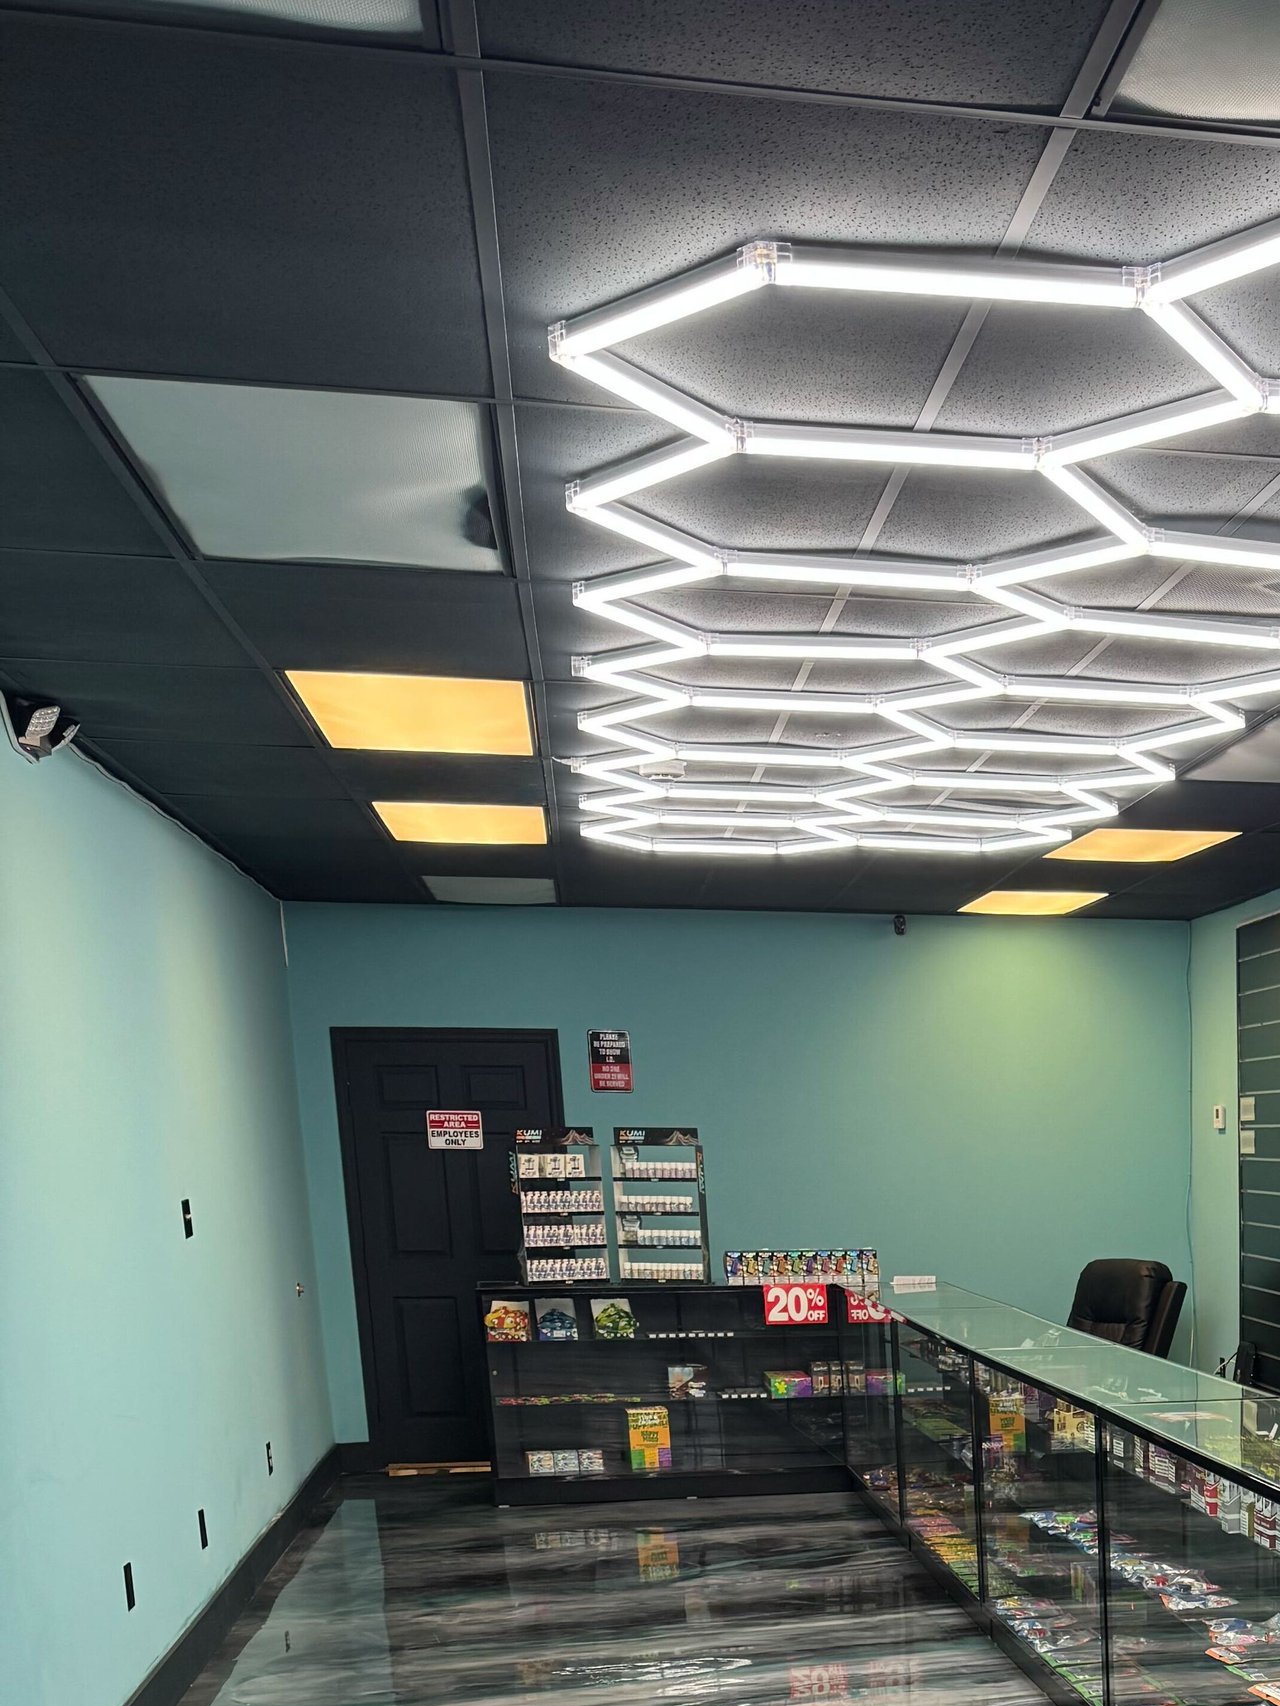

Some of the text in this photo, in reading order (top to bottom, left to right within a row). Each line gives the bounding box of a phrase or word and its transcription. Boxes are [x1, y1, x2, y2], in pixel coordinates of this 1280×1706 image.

[431, 1130, 480, 1138] EMPLOYEES
[444, 1138, 467, 1146] ONLY
[767, 1287, 825, 1322] 20%
[807, 1310, 826, 1321] OFF
